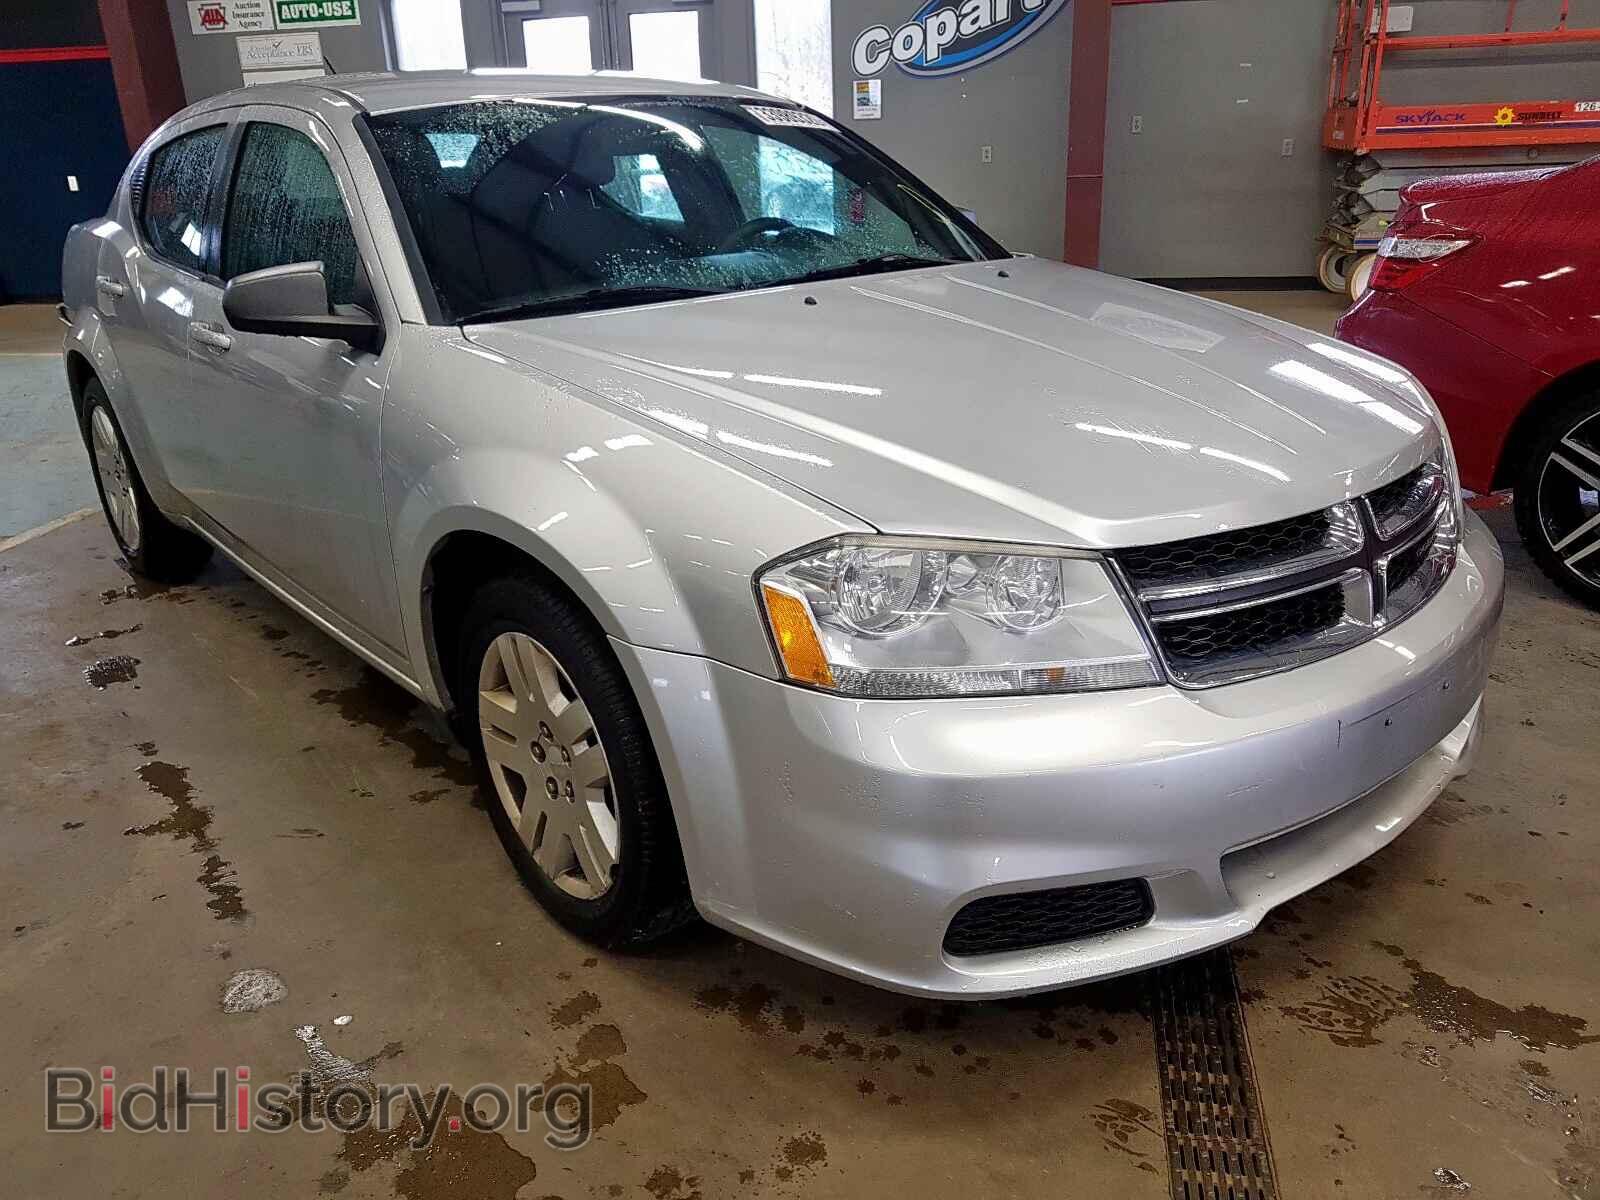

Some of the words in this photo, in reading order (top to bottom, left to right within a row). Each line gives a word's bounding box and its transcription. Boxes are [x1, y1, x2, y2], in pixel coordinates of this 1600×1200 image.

[235, 1, 261, 10] Auction
[232, 10, 265, 19] Insurance
[239, 19, 263, 29] Agency
[1577, 102, 1600, 111] 126
[1395, 110, 1466, 124] SKYJACK
